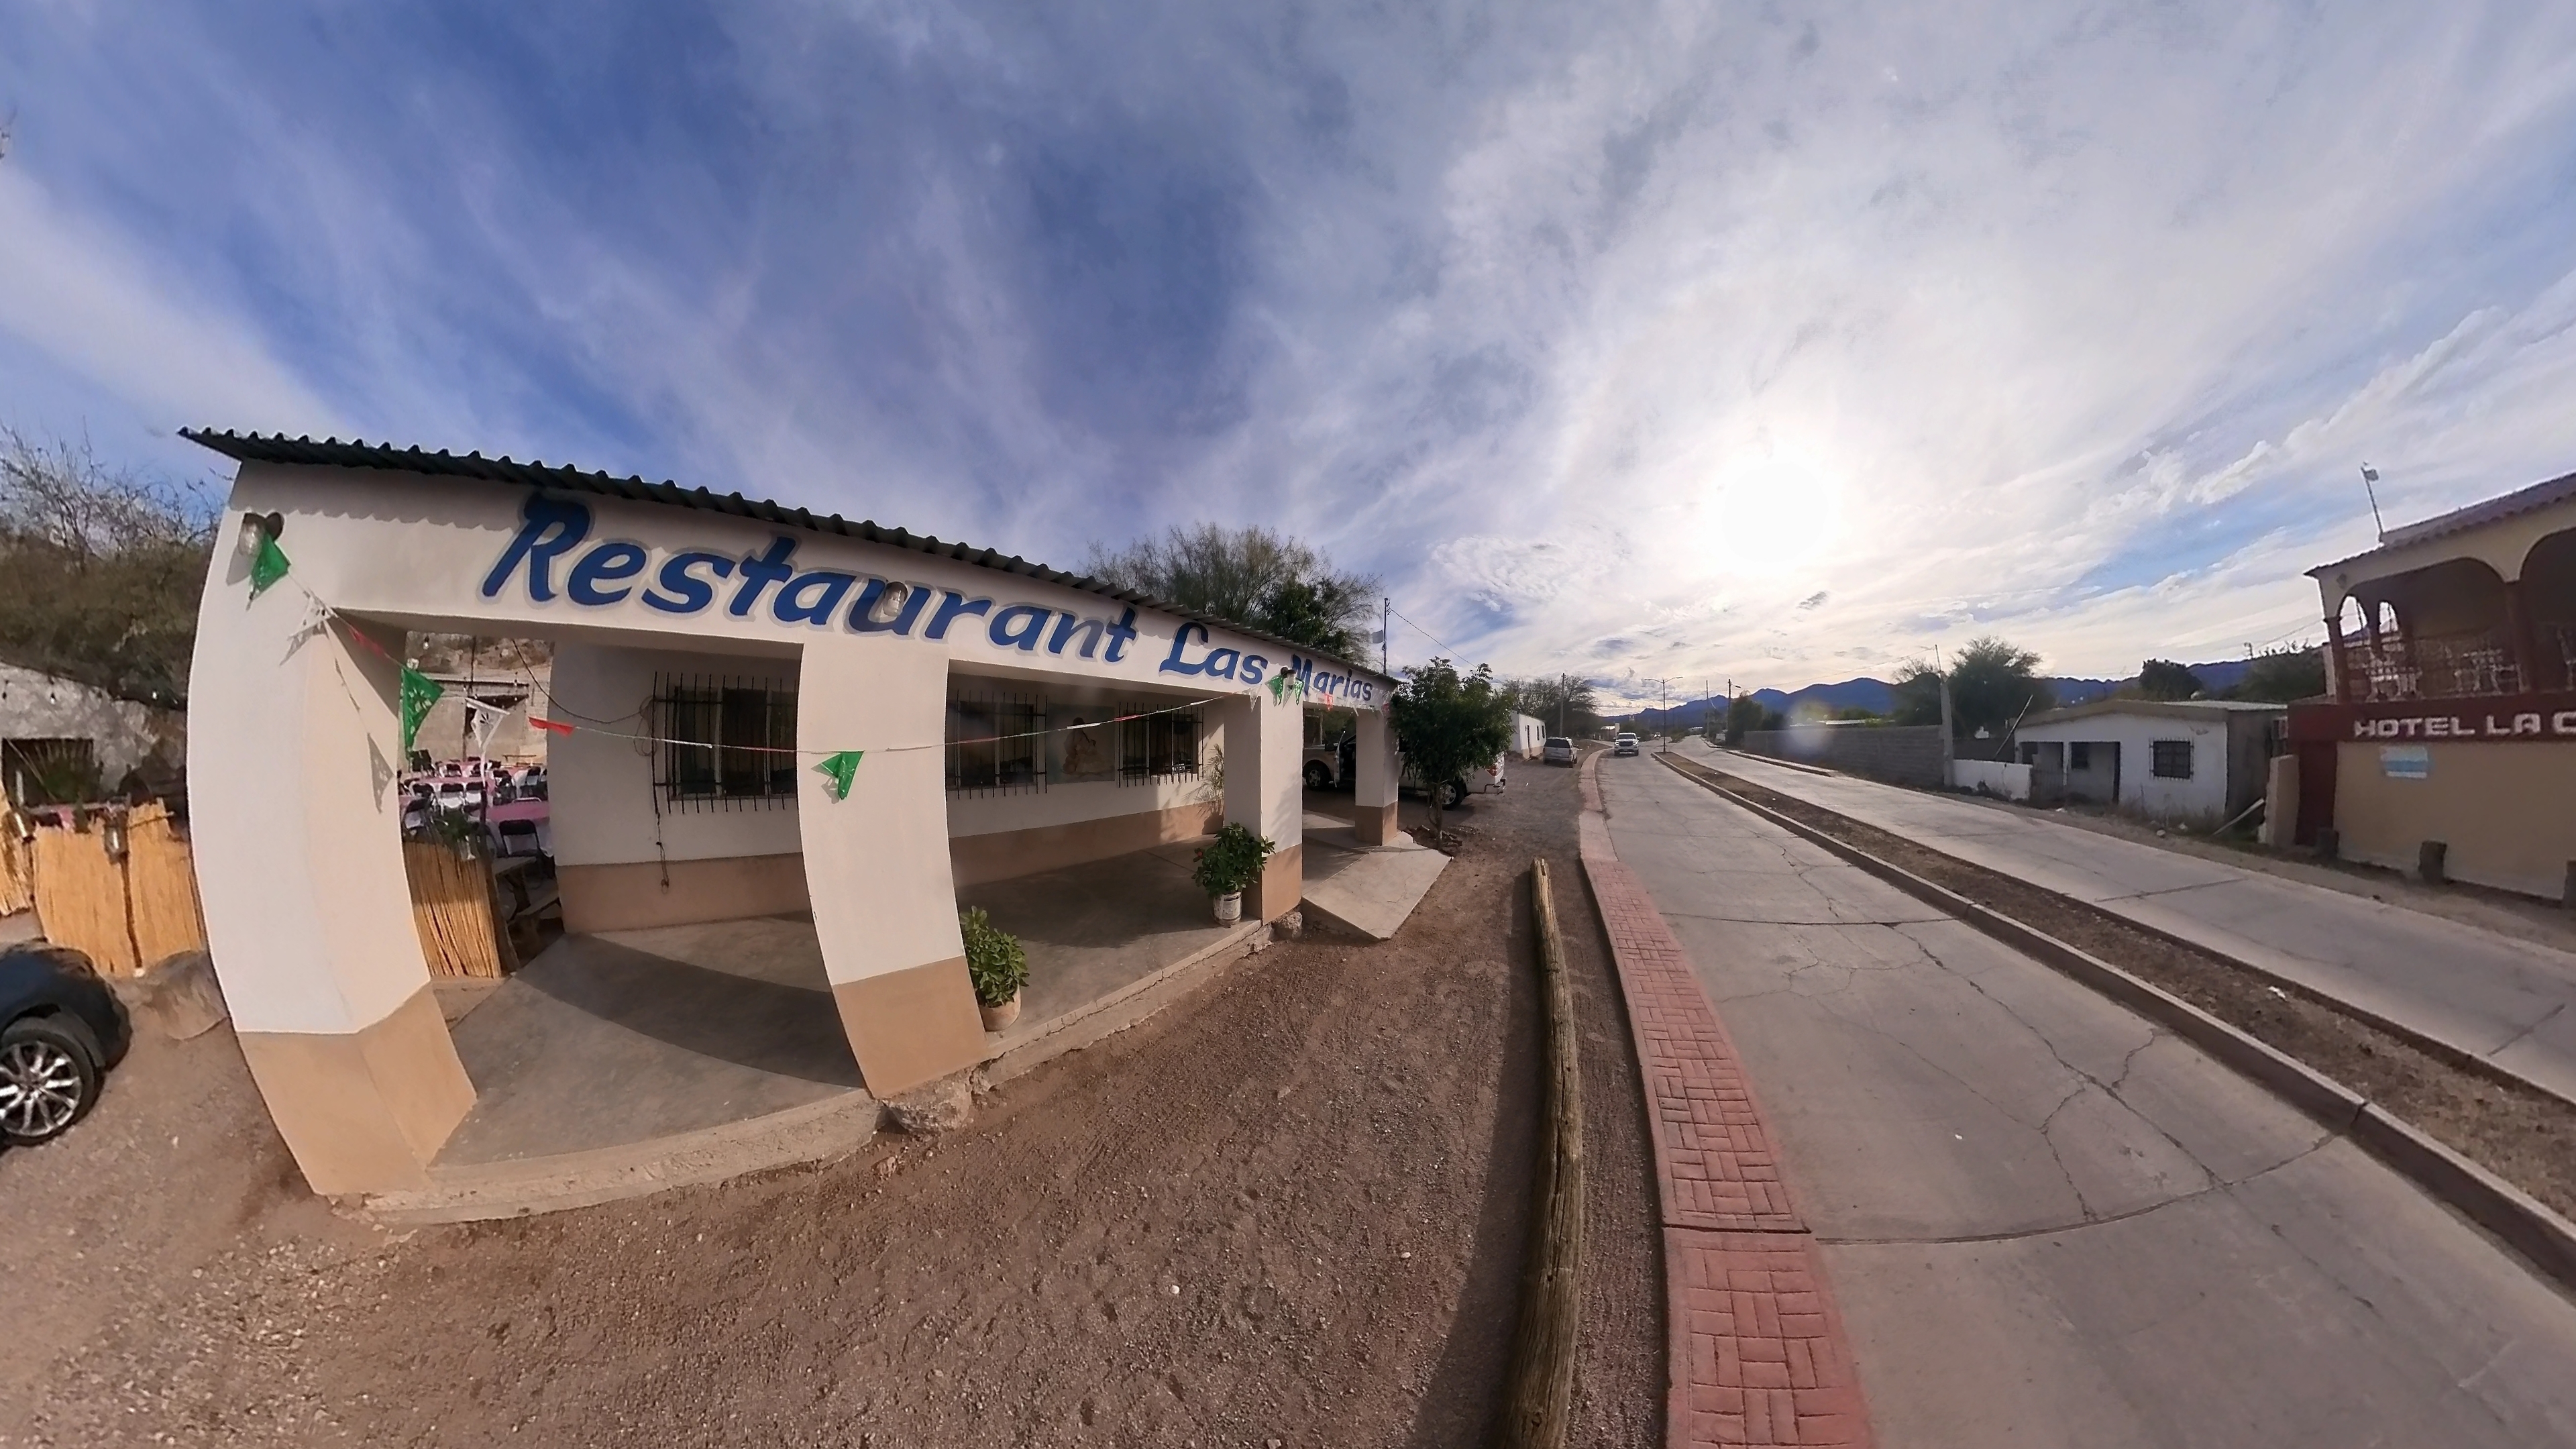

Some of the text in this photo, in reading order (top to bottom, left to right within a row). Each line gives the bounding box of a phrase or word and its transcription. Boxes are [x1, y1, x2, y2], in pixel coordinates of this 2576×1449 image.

[481, 490, 1373, 702] Restaurant Las Marias
[2353, 716, 2476, 737] HOTEL
[2485, 713, 2541, 735] LA
